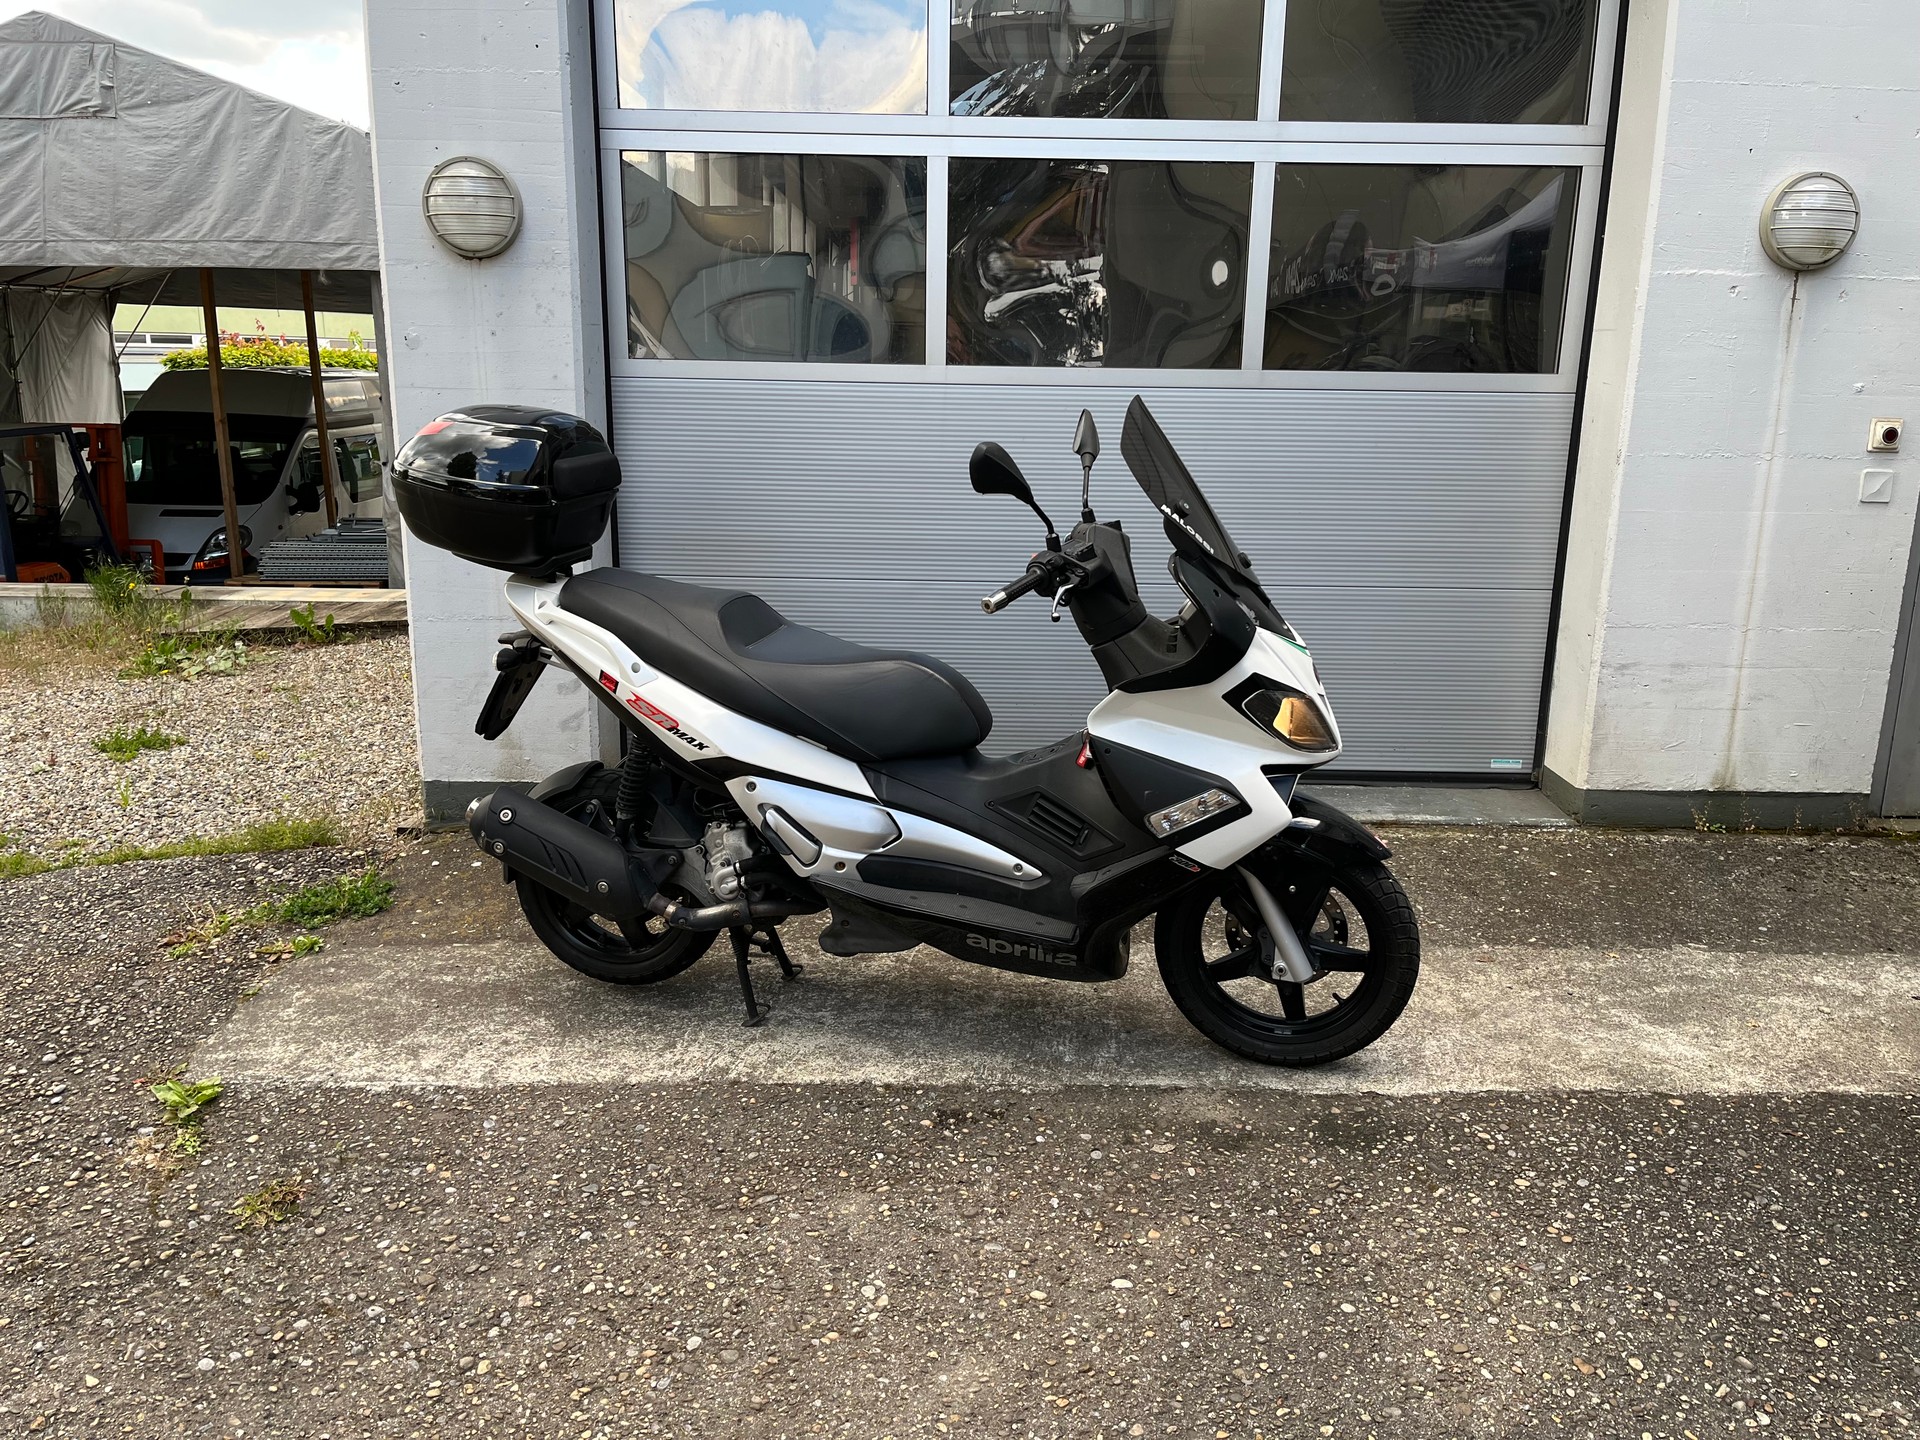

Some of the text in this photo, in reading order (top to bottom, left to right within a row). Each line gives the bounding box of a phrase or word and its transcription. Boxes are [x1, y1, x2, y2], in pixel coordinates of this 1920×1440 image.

[1160, 504, 1215, 555] MALOSSI
[625, 690, 710, 752] SR MAX
[966, 933, 1078, 967] aprilia
